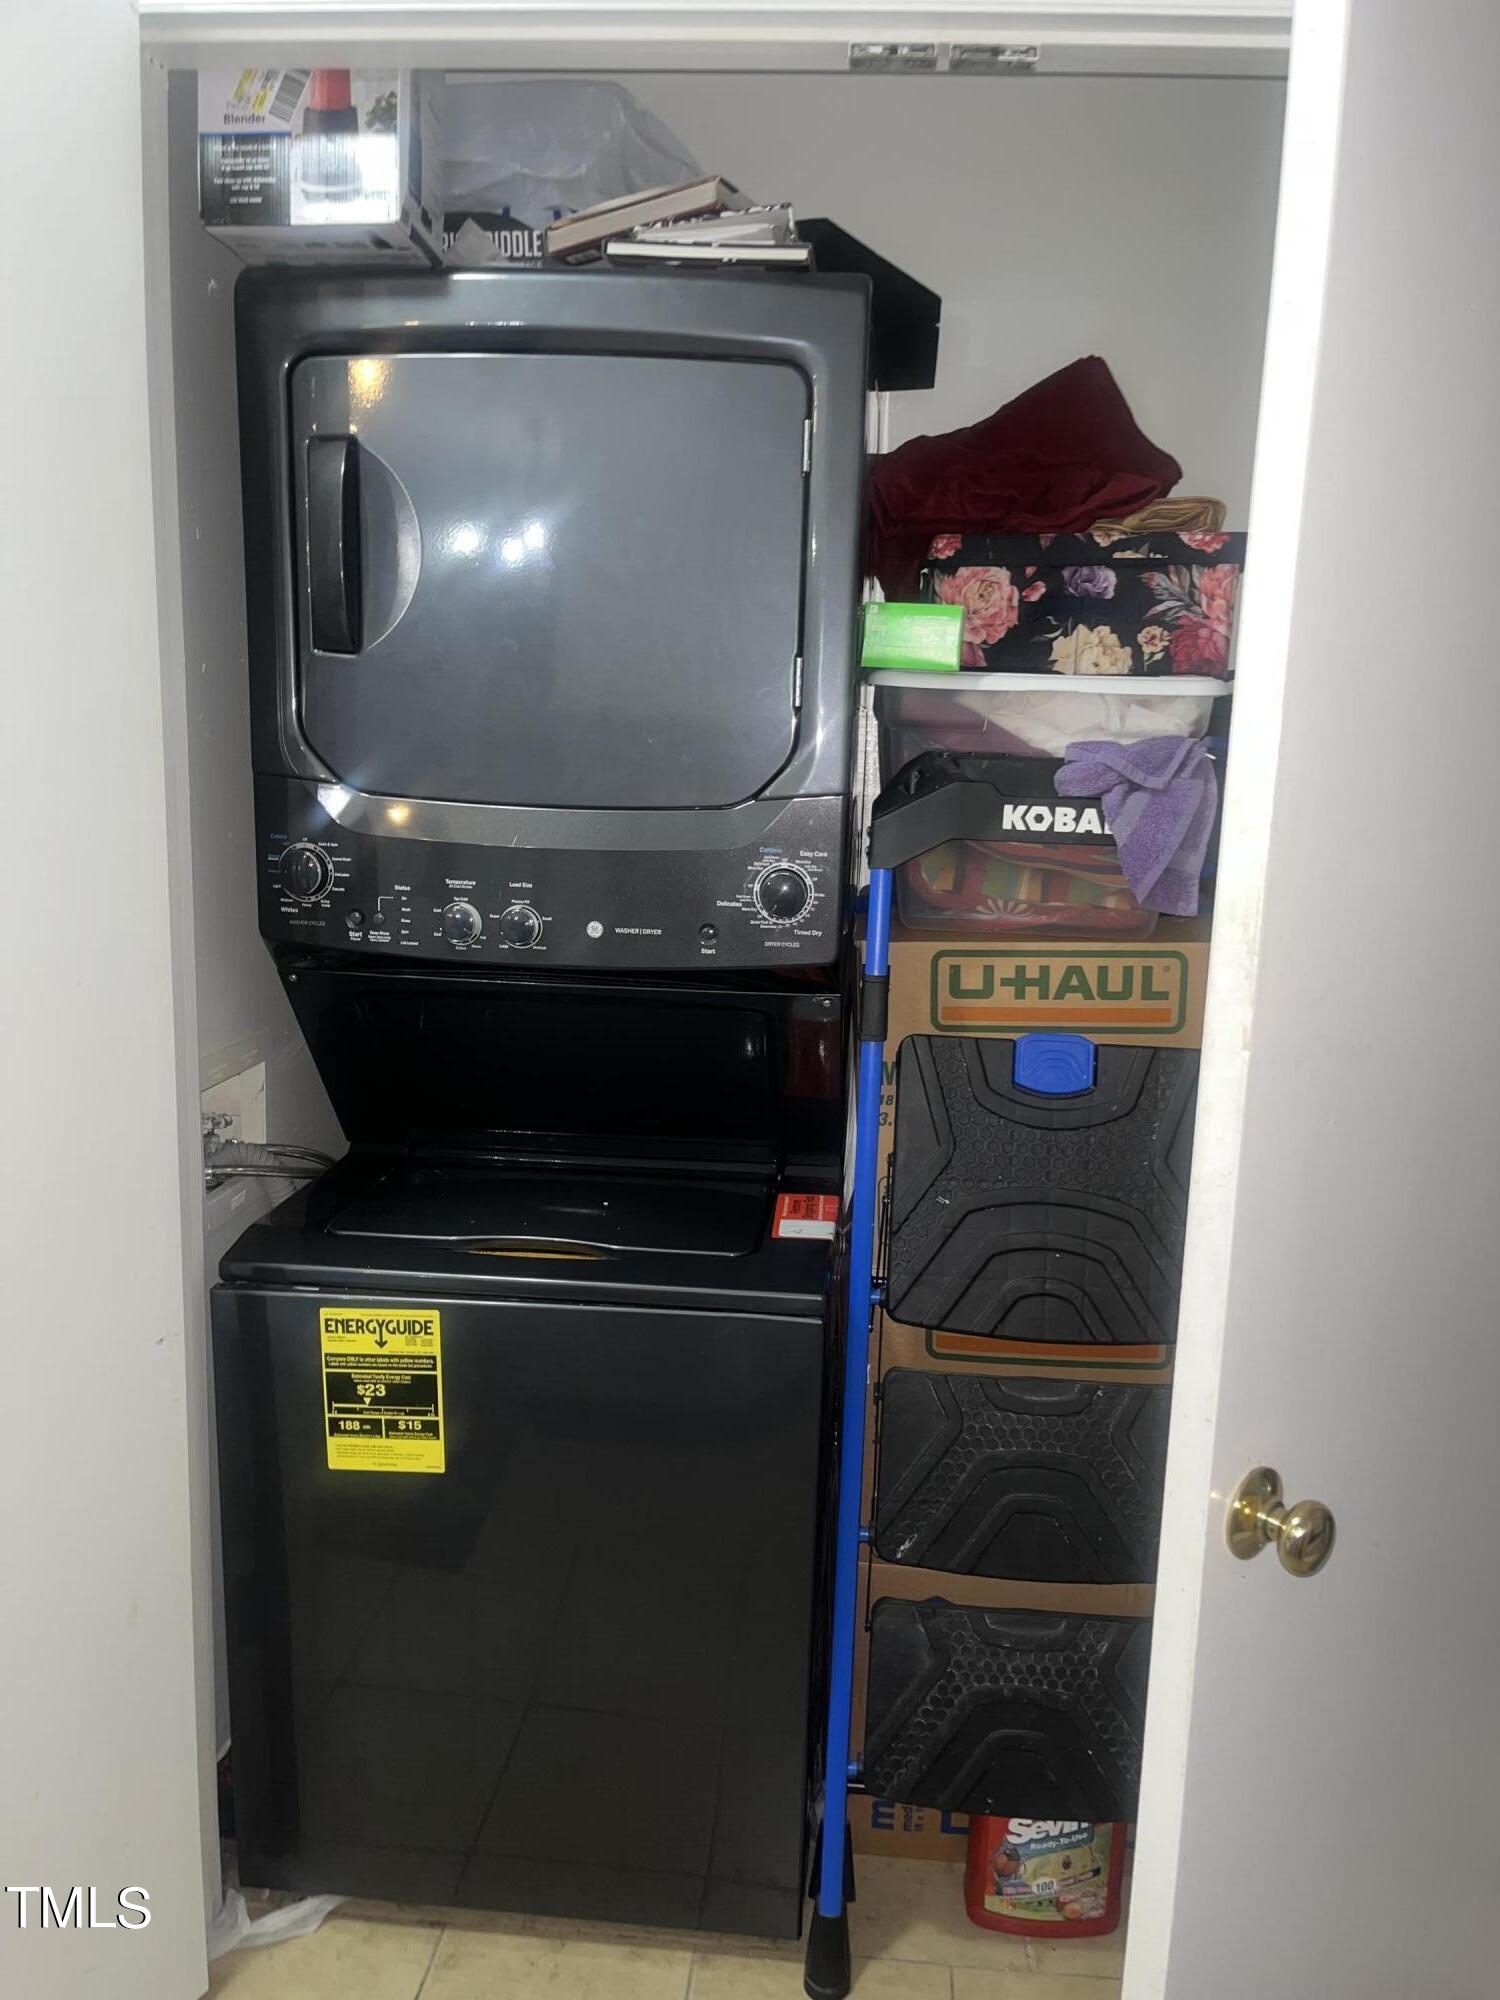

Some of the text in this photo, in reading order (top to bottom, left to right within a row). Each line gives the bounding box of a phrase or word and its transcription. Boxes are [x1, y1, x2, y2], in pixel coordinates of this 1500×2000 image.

[223, 113, 265, 125] Blender
[1002, 804, 1114, 835] KOBA
[800, 850, 813, 858] Easy
[949, 964, 1170, 1001] U-HAUL
[356, 1383, 386, 1397] $23
[338, 1420, 360, 1430] 188
[398, 1420, 422, 1431] $15
[1030, 1832, 1089, 1851] Ready-To-Use
[1035, 1880, 1055, 1893] 100
